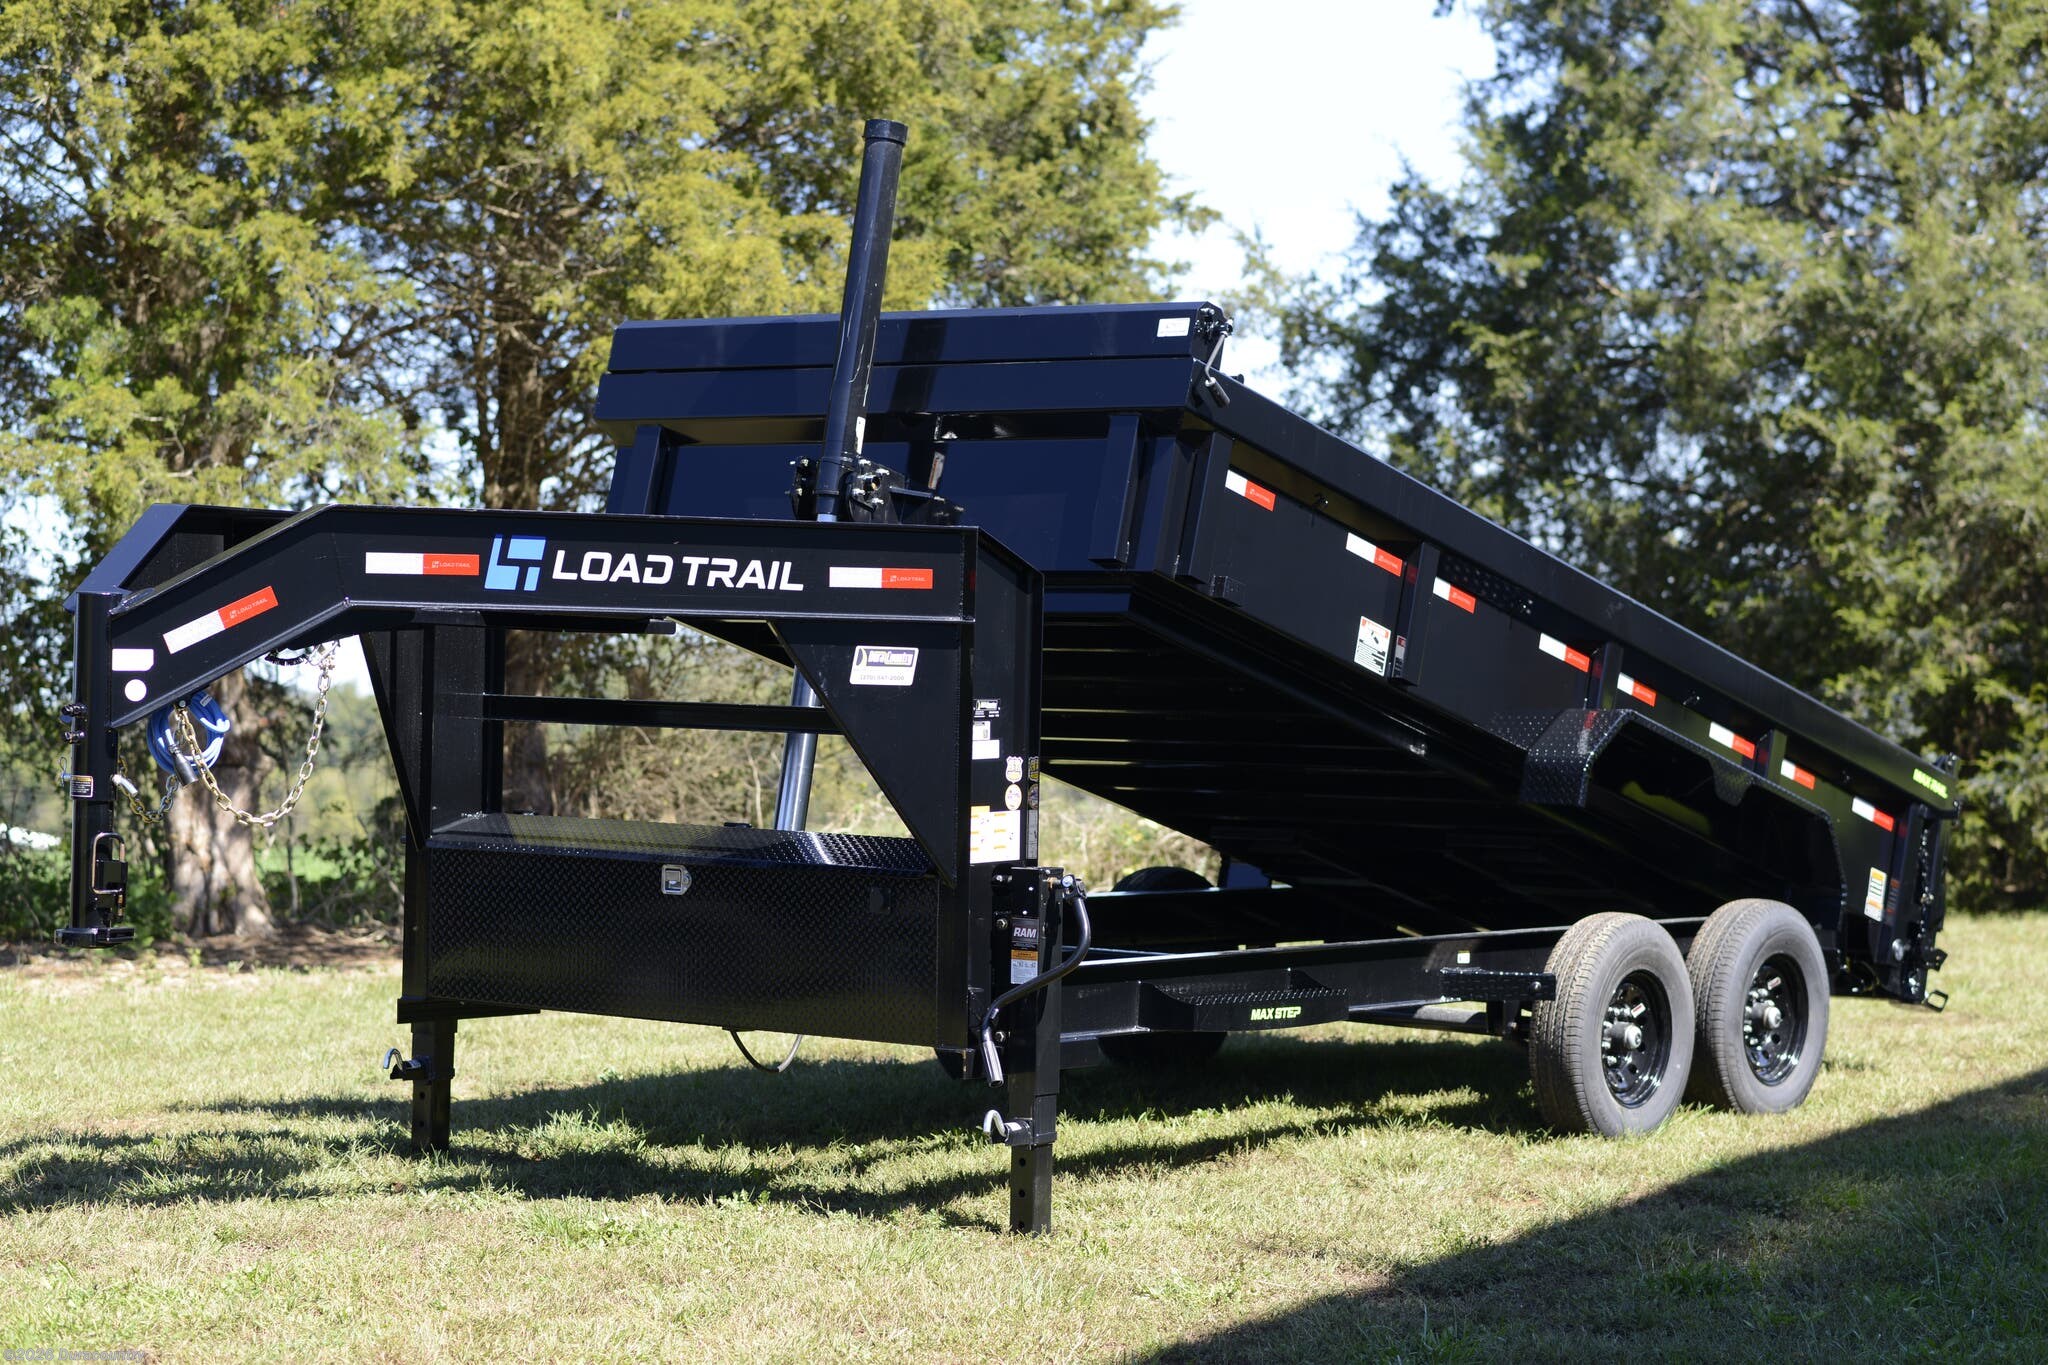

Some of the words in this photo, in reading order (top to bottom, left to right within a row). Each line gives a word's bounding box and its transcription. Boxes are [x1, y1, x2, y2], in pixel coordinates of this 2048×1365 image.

[552, 549, 674, 585] LOAD
[682, 556, 804, 592] TRAIL
[1013, 926, 1037, 938] RAM
[1250, 1008, 1275, 1021] MAX
[1275, 1006, 1302, 1019] STEP
